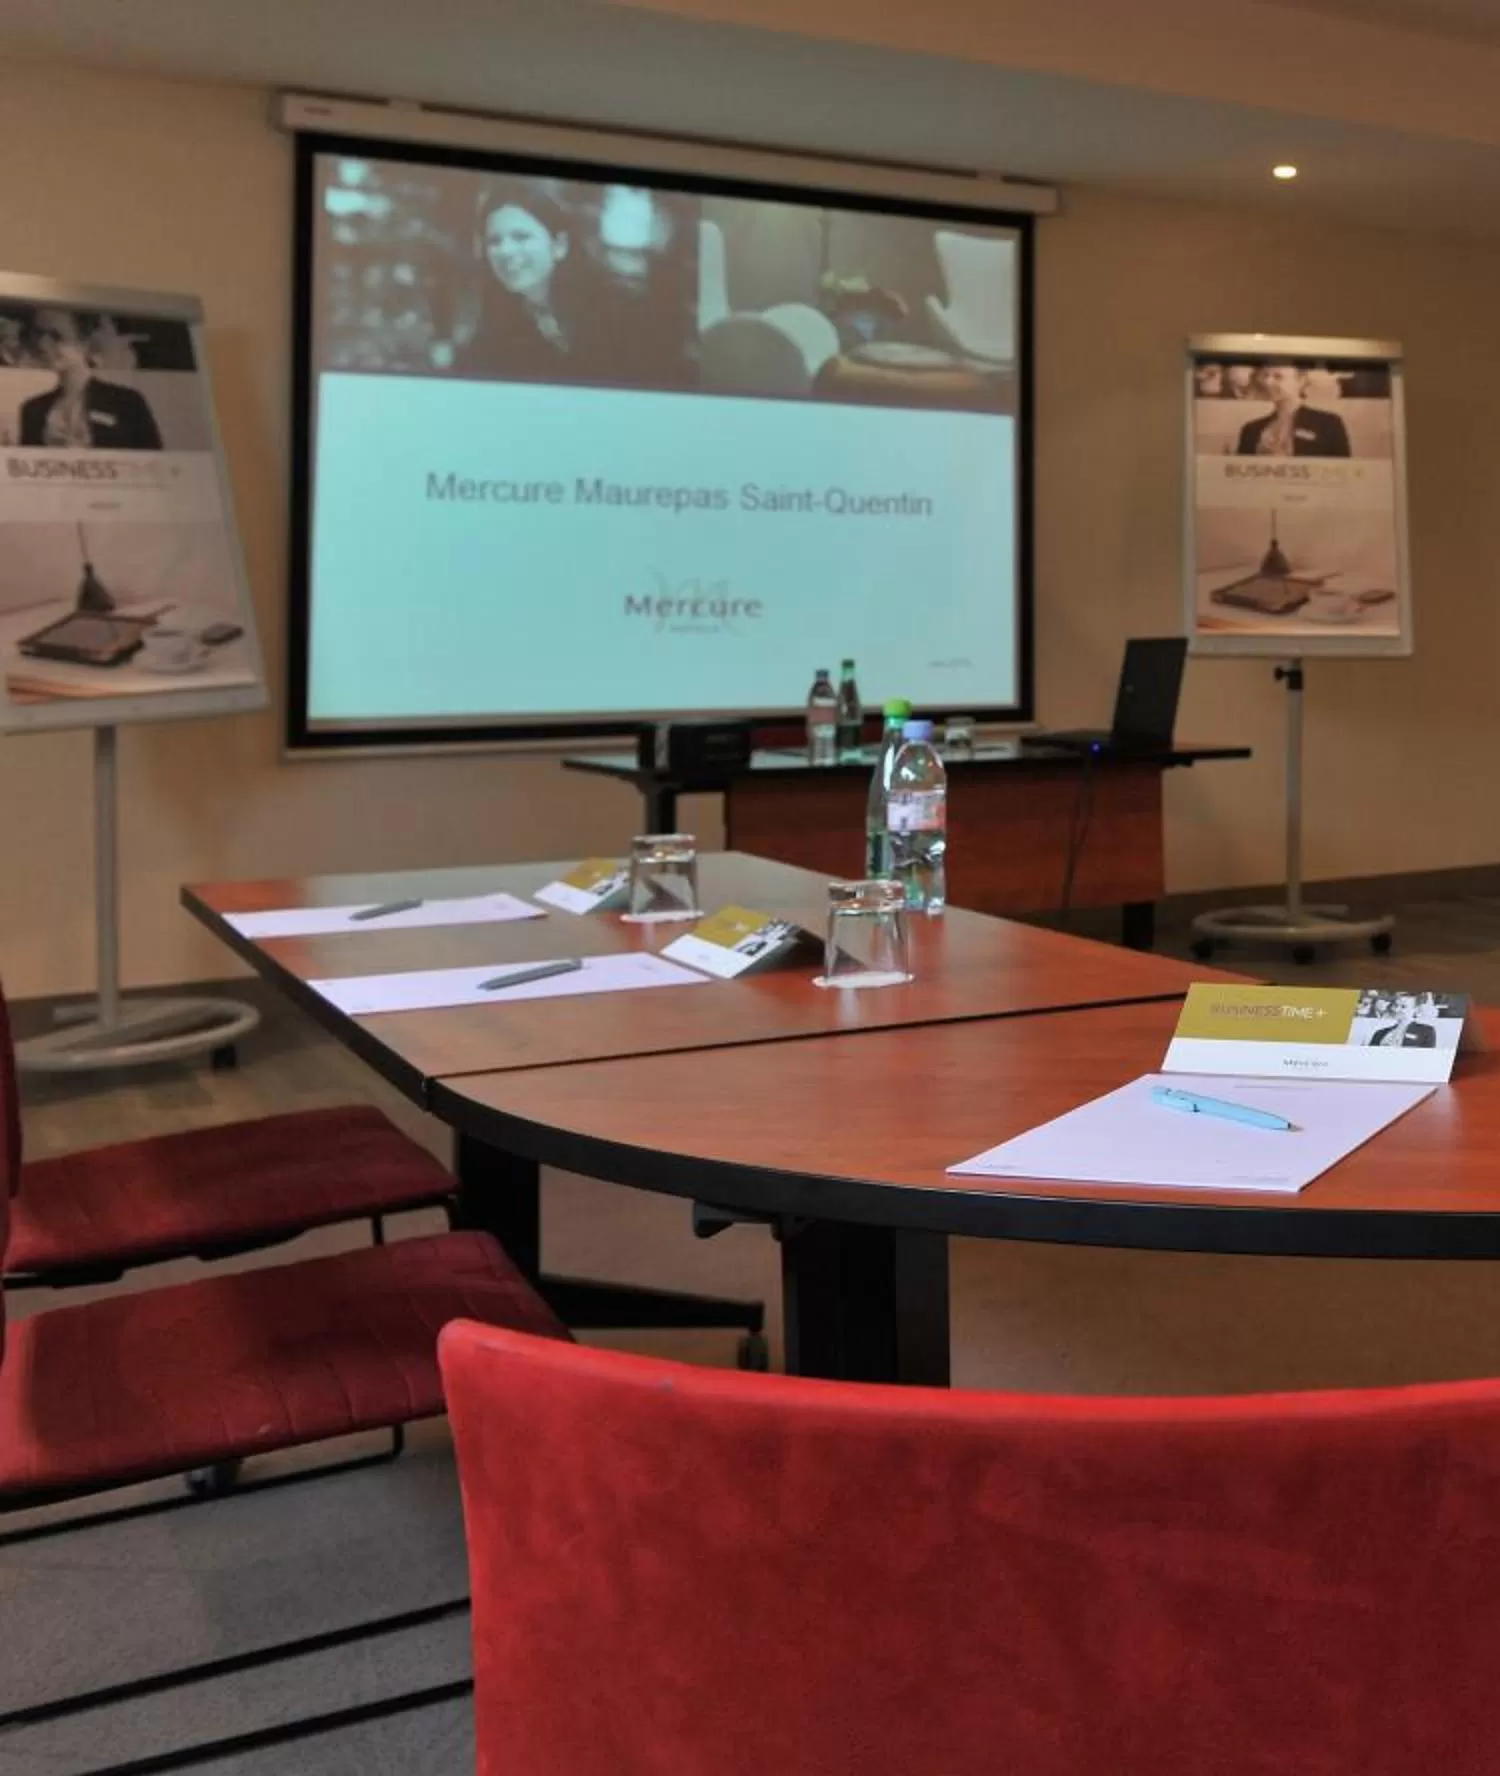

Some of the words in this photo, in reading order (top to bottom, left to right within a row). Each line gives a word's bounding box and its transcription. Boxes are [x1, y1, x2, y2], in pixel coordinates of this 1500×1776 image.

[426, 472, 564, 504] Mercure
[575, 477, 728, 515] Maurepas
[740, 481, 933, 516] Saint-Quentin
[624, 594, 763, 617] Mercure
